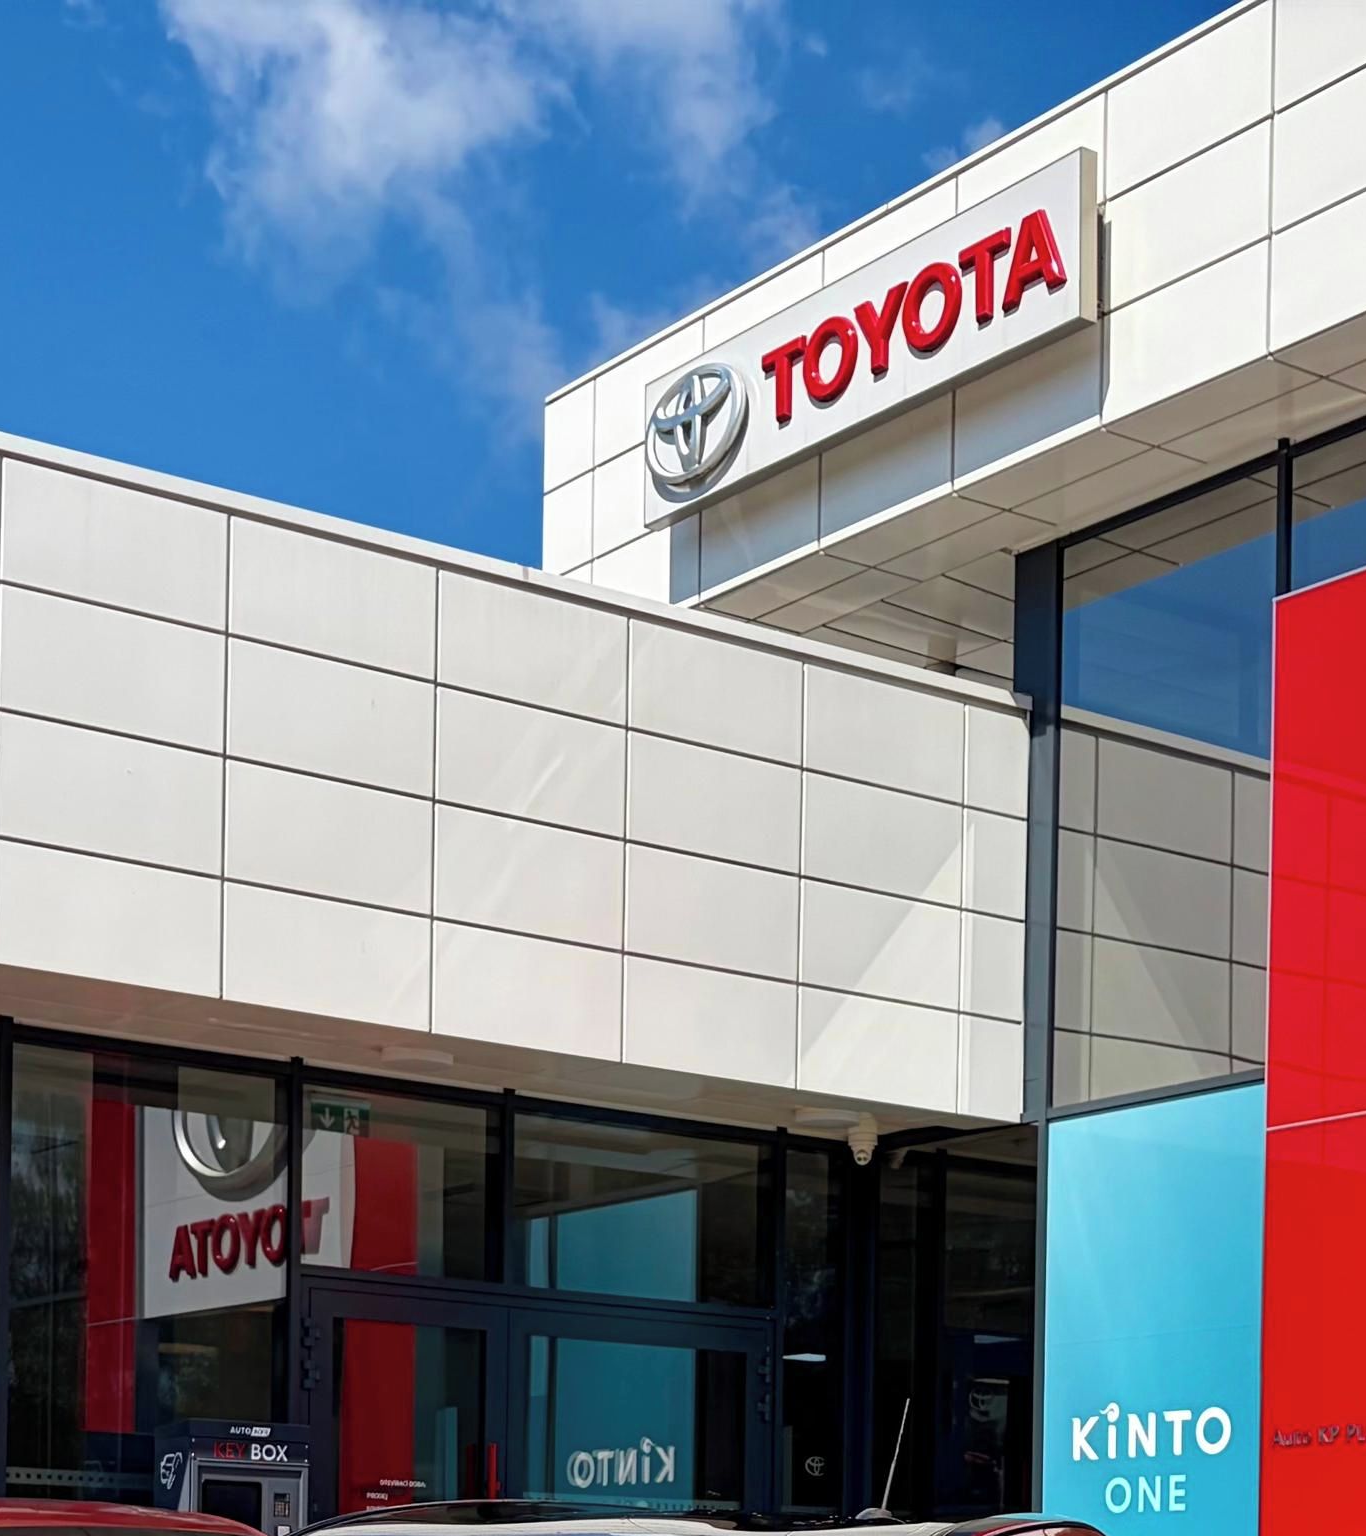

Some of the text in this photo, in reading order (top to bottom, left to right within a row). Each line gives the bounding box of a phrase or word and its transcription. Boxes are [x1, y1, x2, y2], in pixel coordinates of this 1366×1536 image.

[762, 209, 1067, 425] TOYOTA
[1318, 1425, 1339, 1443] KP
[213, 1441, 288, 1462] KEY BOX
[1105, 1475, 1188, 1514] ONE
